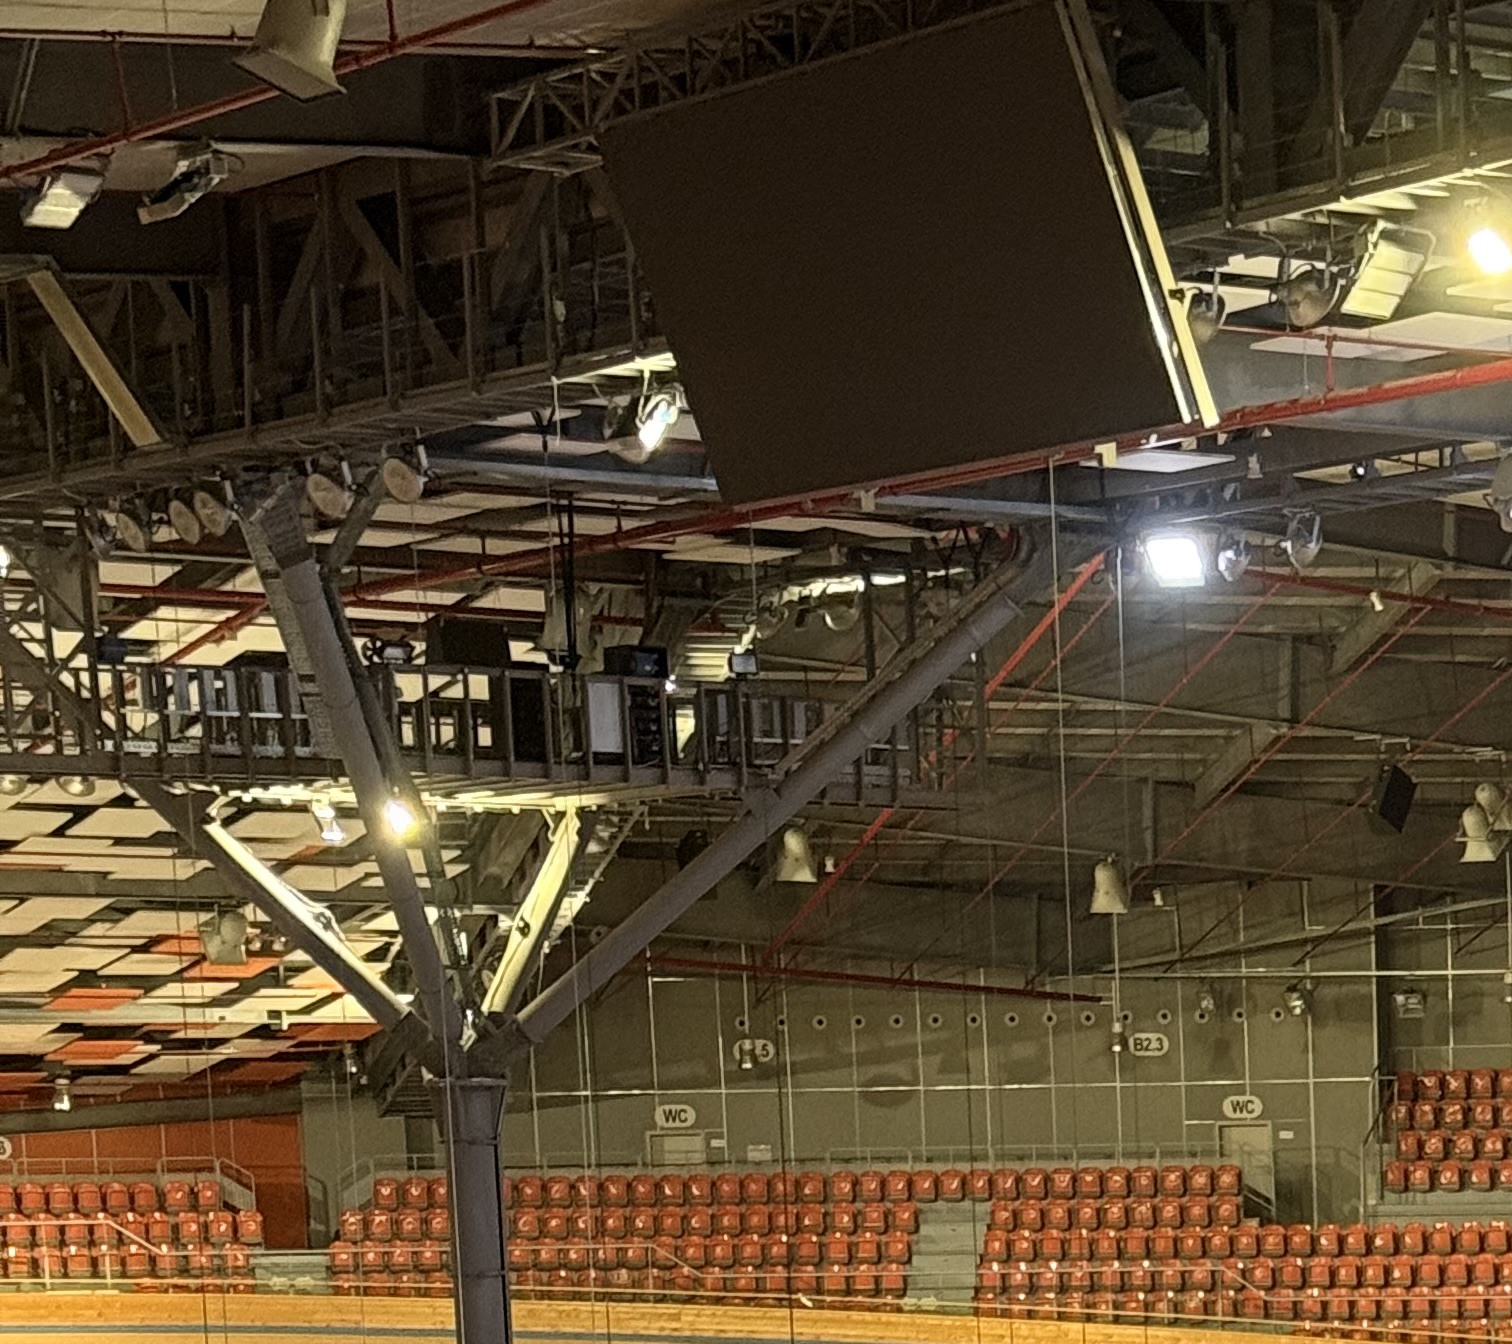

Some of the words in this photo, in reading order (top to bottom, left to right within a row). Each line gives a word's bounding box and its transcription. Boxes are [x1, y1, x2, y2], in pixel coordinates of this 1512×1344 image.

[1133, 1037, 1164, 1051] B2.3
[1231, 1100, 1256, 1115] WC
[662, 1108, 689, 1124] WC
